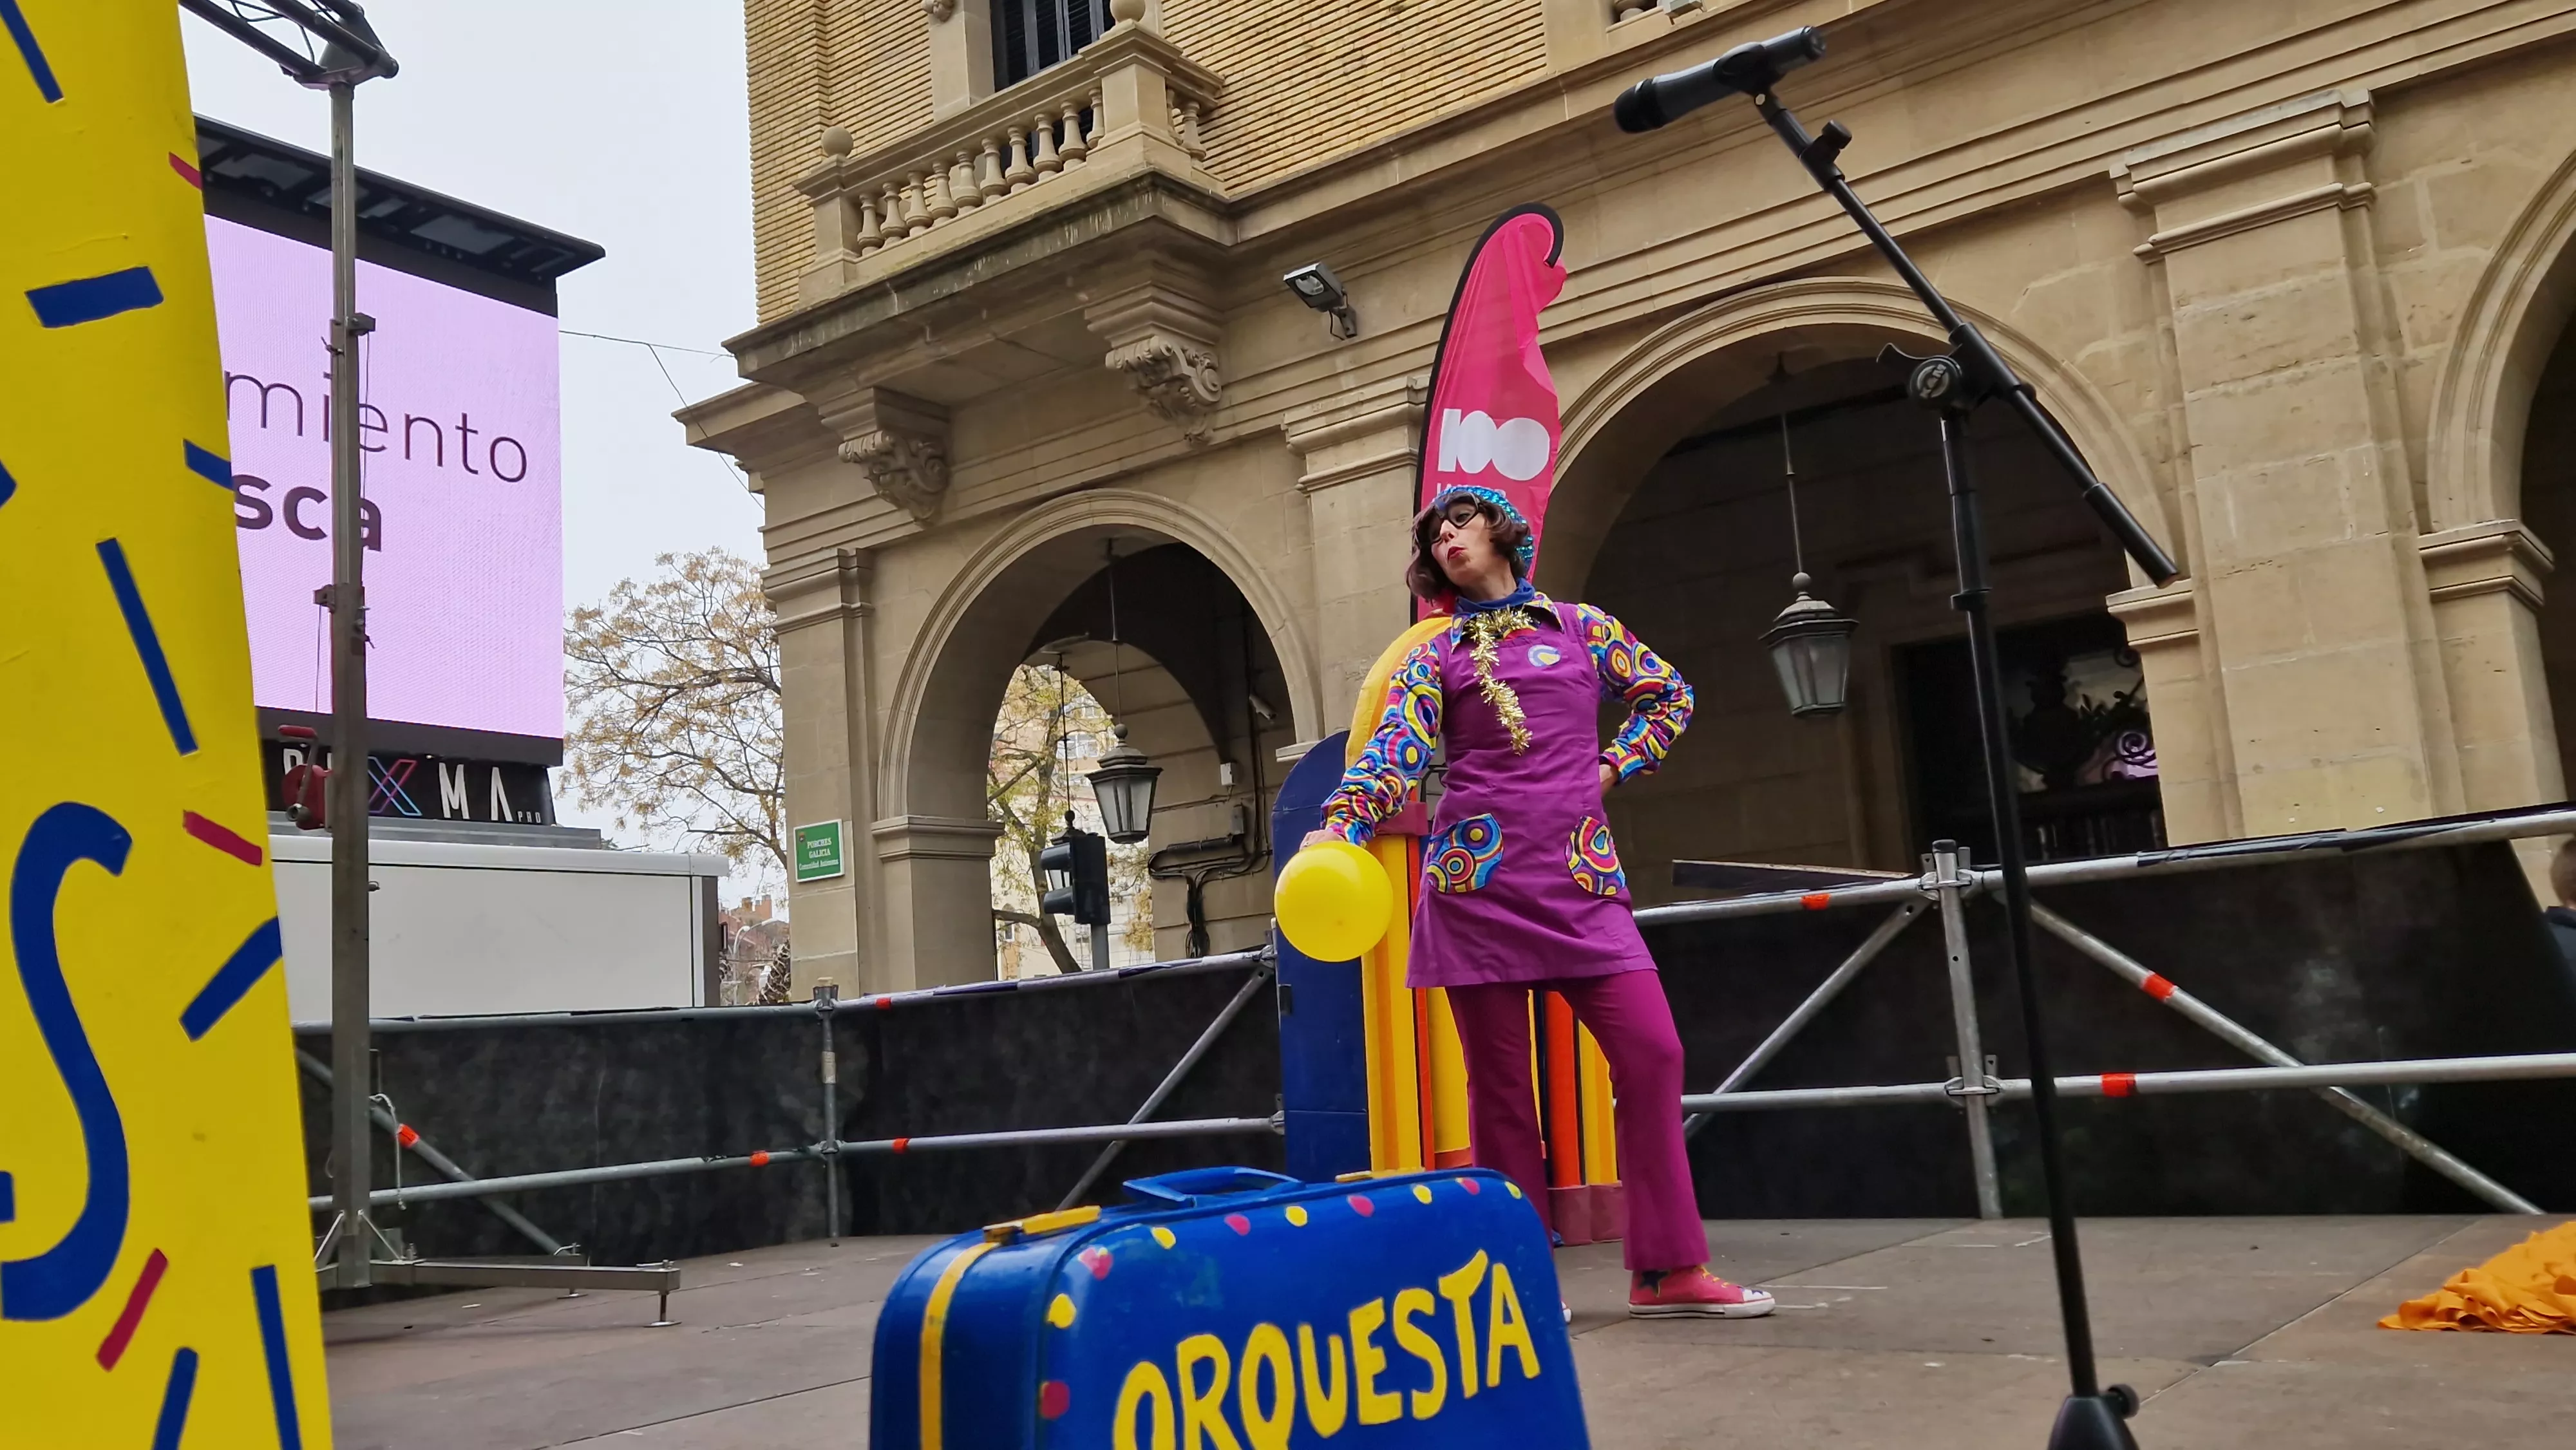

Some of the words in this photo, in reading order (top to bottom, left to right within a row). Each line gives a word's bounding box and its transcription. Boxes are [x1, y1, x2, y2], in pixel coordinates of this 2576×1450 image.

[1437, 408, 1551, 481] 100
[807, 837, 832, 849] PORCHES
[809, 849, 831, 859] GALICIA
[1112, 1248, 1540, 1450] ORQUESTA
